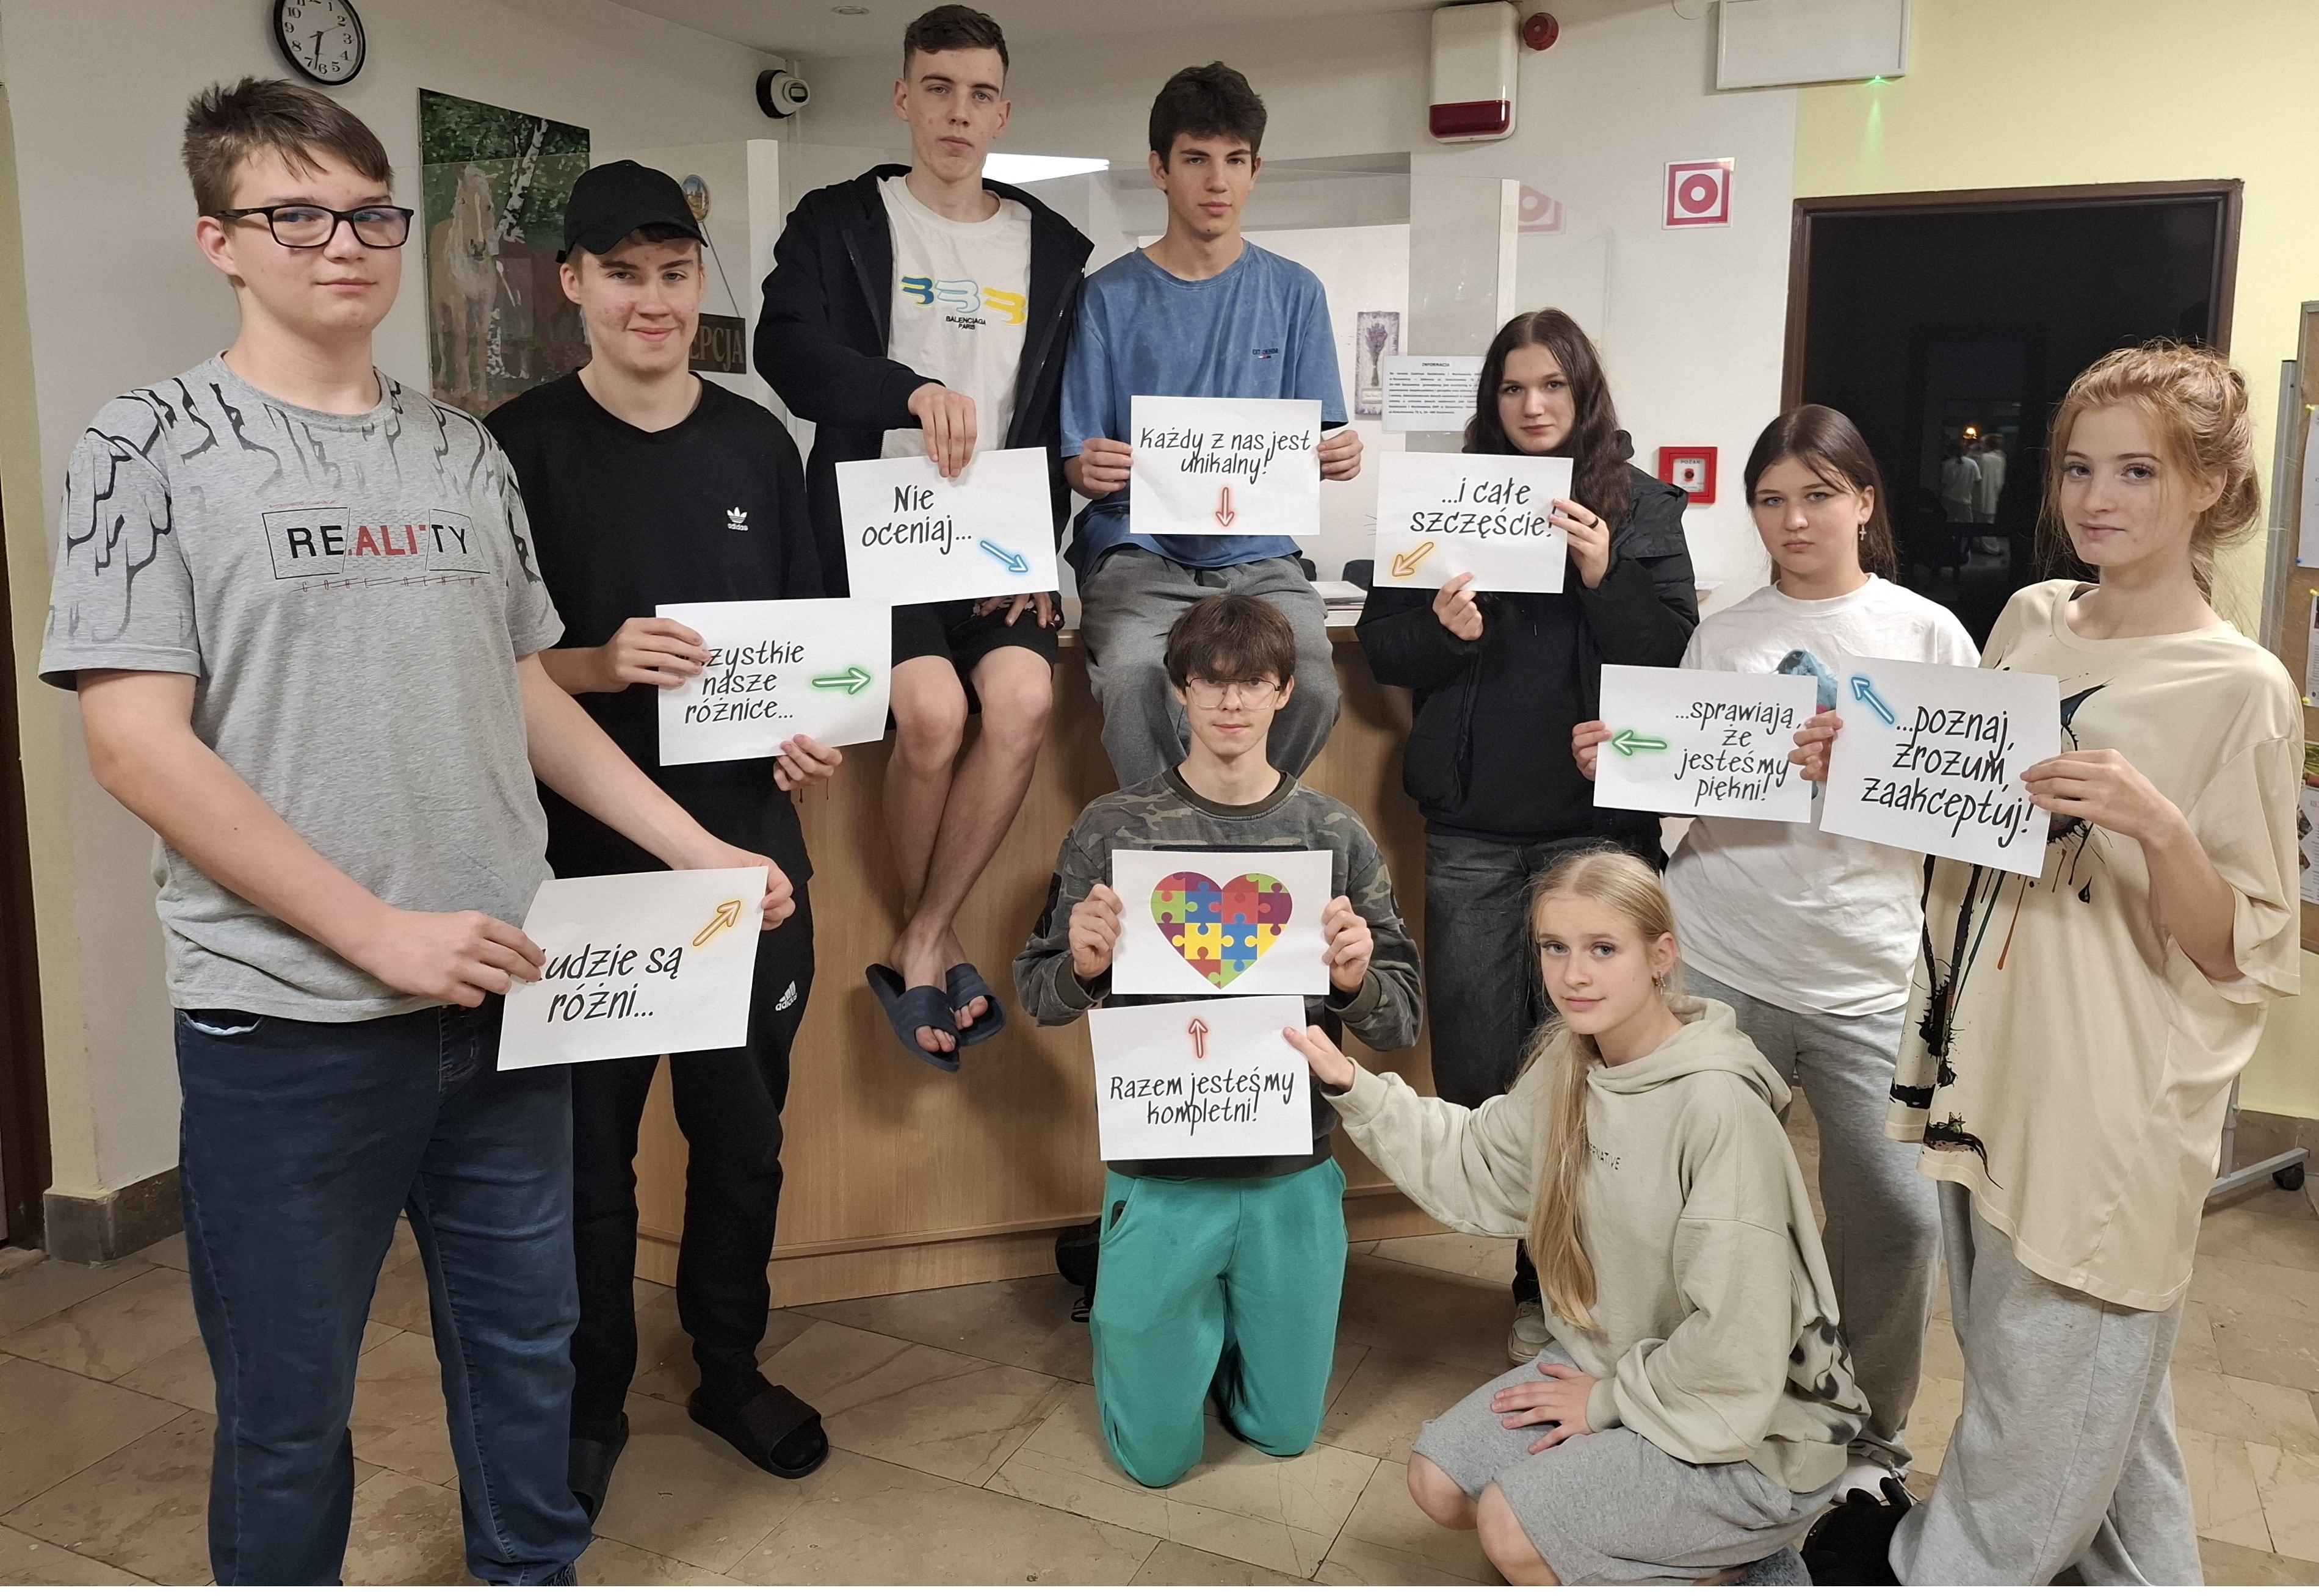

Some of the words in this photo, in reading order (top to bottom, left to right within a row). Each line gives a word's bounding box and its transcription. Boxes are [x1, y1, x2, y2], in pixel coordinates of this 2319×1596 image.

[288, 7, 302, 18] 10
[328, 2, 332, 11] 1
[337, 15, 345, 26] 2
[284, 22, 294, 33] 9
[343, 33, 352, 44] 3
[292, 40, 302, 52] 8
[339, 51, 349, 60] 4
[305, 57, 313, 67] 7
[318, 63, 327, 74] 6
[331, 62, 341, 72] 5
[1140, 427, 1203, 460] Każdy
[1211, 433, 1225, 449] z
[1231, 433, 1264, 451] nas
[1267, 430, 1311, 461] jest
[1181, 447, 1271, 485] unikalny!
[894, 485, 935, 513] Nie
[1473, 477, 1531, 505] całe
[861, 515, 972, 555] oceniaj...
[1409, 505, 1557, 539] szczęście!
[675, 639, 805, 678] zystkie
[702, 673, 778, 696] nasze
[684, 697, 794, 724] różnice...
[1675, 701, 1803, 735] ...sprawiają,
[1721, 724, 1753, 747] że
[1896, 706, 2014, 760] ...poznaj,
[1674, 748, 1789, 788] jesteśmy
[1892, 743, 2009, 792] zrozum,
[1694, 772, 1771, 807] piękni!
[1861, 777, 2035, 848] zaakceptuj!
[526, 943, 639, 983] udzie
[645, 947, 683, 980] są
[547, 983, 654, 1024] różni...
[775, 993, 797, 1011] adida
[1110, 1076, 1183, 1100] Razem
[1185, 1066, 1294, 1108] jesteśmy
[1147, 1091, 1259, 1136] kompletni!
